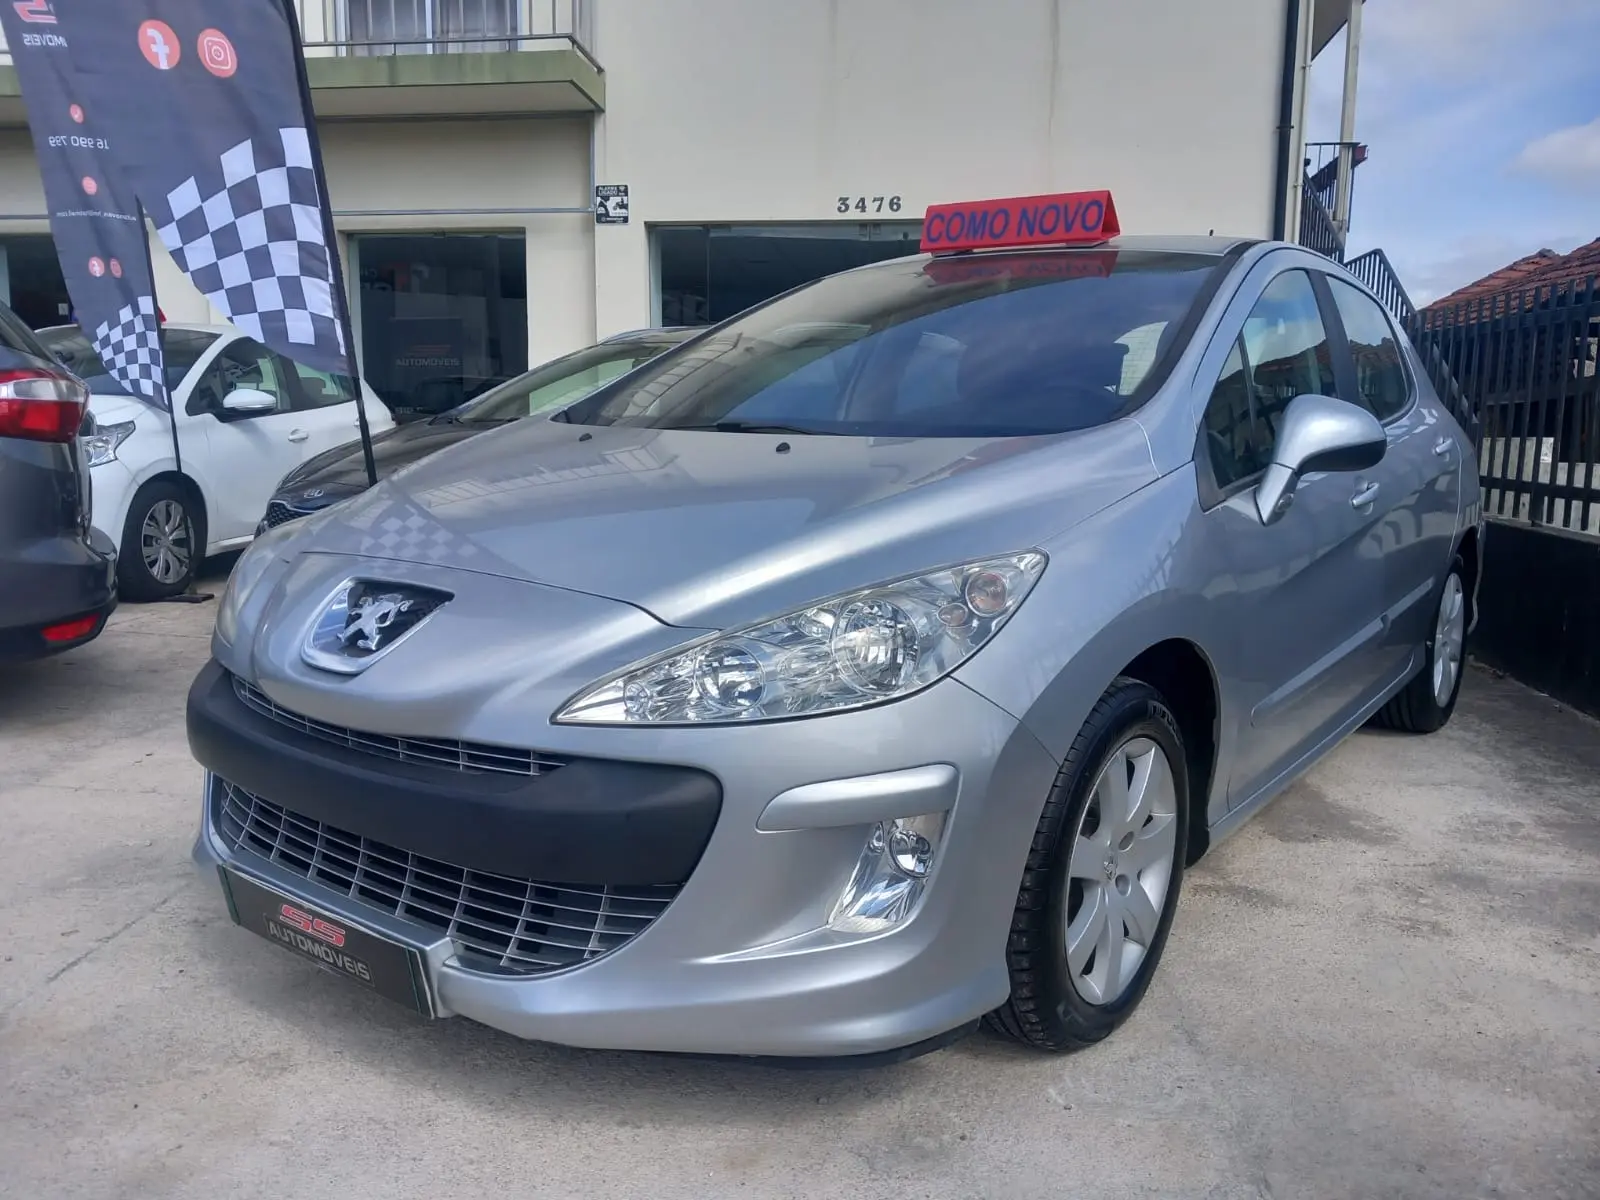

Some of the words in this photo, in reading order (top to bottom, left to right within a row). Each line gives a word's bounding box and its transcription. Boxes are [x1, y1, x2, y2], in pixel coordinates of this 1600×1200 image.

[837, 196, 902, 213] 3476
[926, 208, 1010, 243] COMO
[1017, 199, 1104, 237] NOVO
